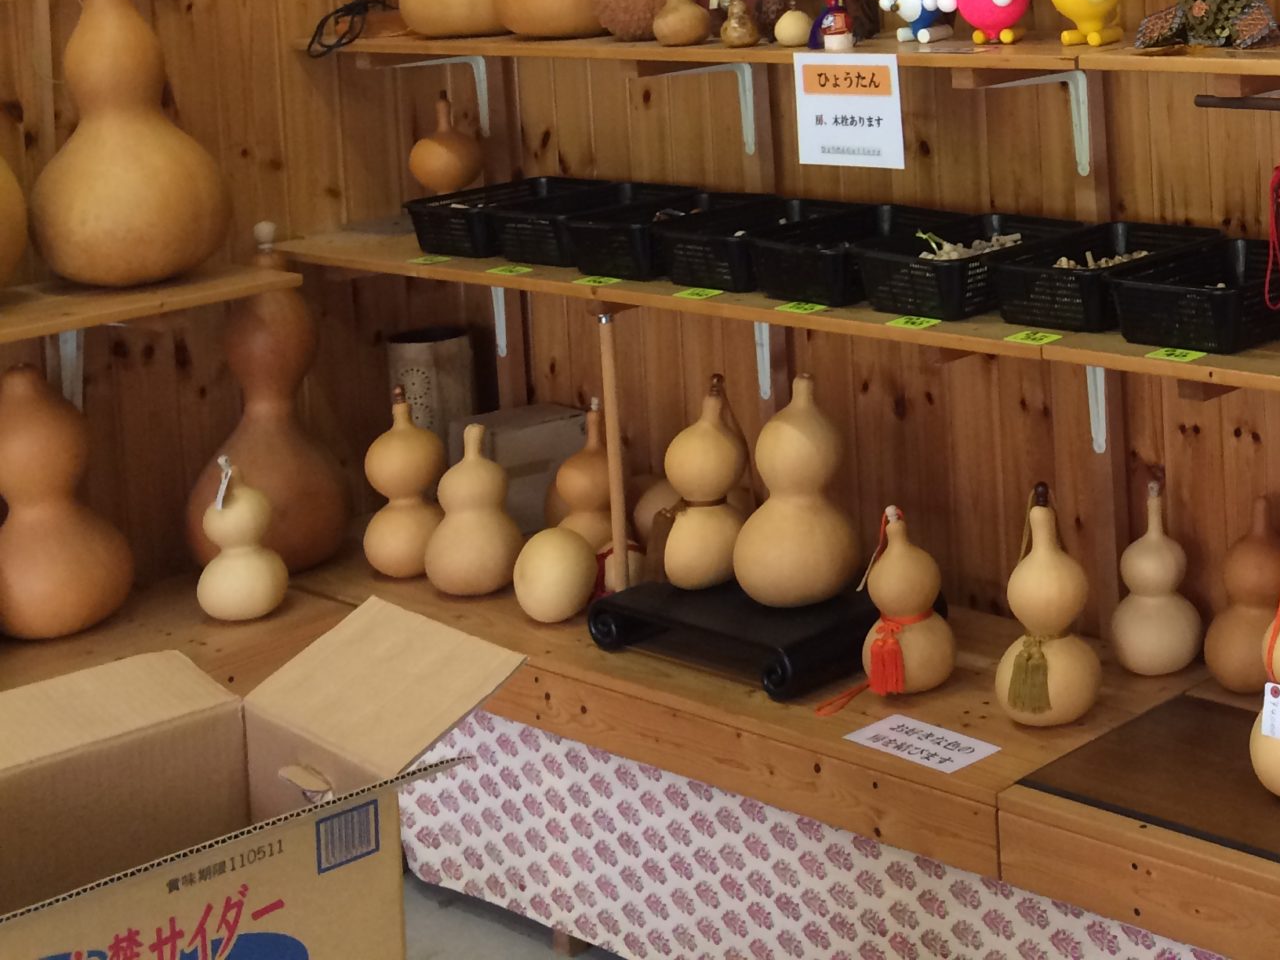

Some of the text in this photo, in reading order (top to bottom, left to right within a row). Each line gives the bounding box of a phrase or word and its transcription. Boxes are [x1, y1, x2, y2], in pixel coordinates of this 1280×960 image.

[816, 71, 881, 89] ひょうたん
